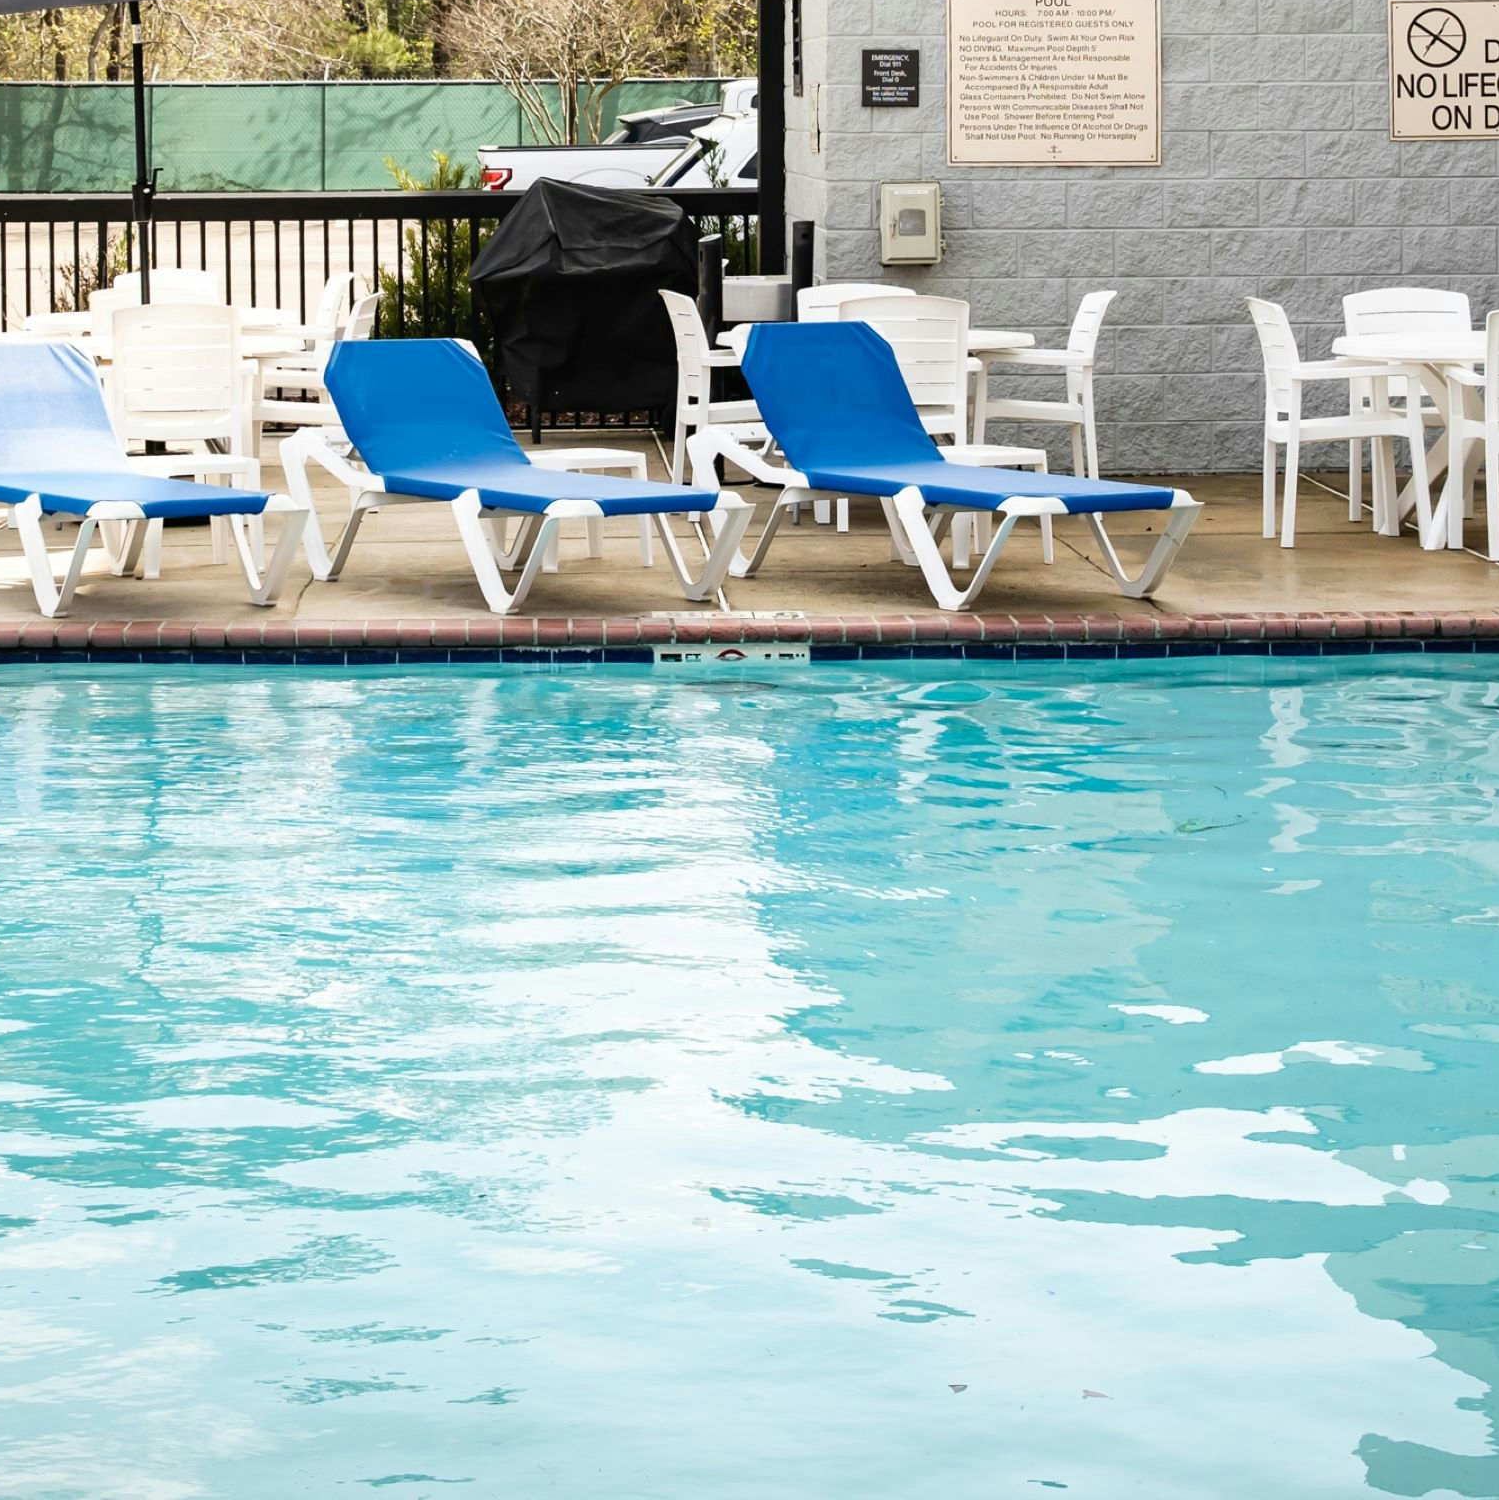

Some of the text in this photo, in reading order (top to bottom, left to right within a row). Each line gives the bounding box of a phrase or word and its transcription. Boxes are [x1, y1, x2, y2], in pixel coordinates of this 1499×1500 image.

[972, 35, 1008, 43] Lifeguard
[1066, 45, 1090, 53] Depth
[999, 55, 1050, 63] Management
[1083, 55, 1130, 63] Responsible
[1031, 64, 1057, 72] Injuries
[965, 84, 1018, 92] Accompanied
[1020, 84, 1030, 92] By
[1040, 84, 1087, 92] Responsible
[1397, 73, 1437, 98] NO
[1063, 113, 1095, 122] Entering
[1432, 104, 1472, 130] ON
[1125, 124, 1148, 132] Drugs
[1053, 133, 1085, 141] Running
[1098, 133, 1137, 141] Horseplay
